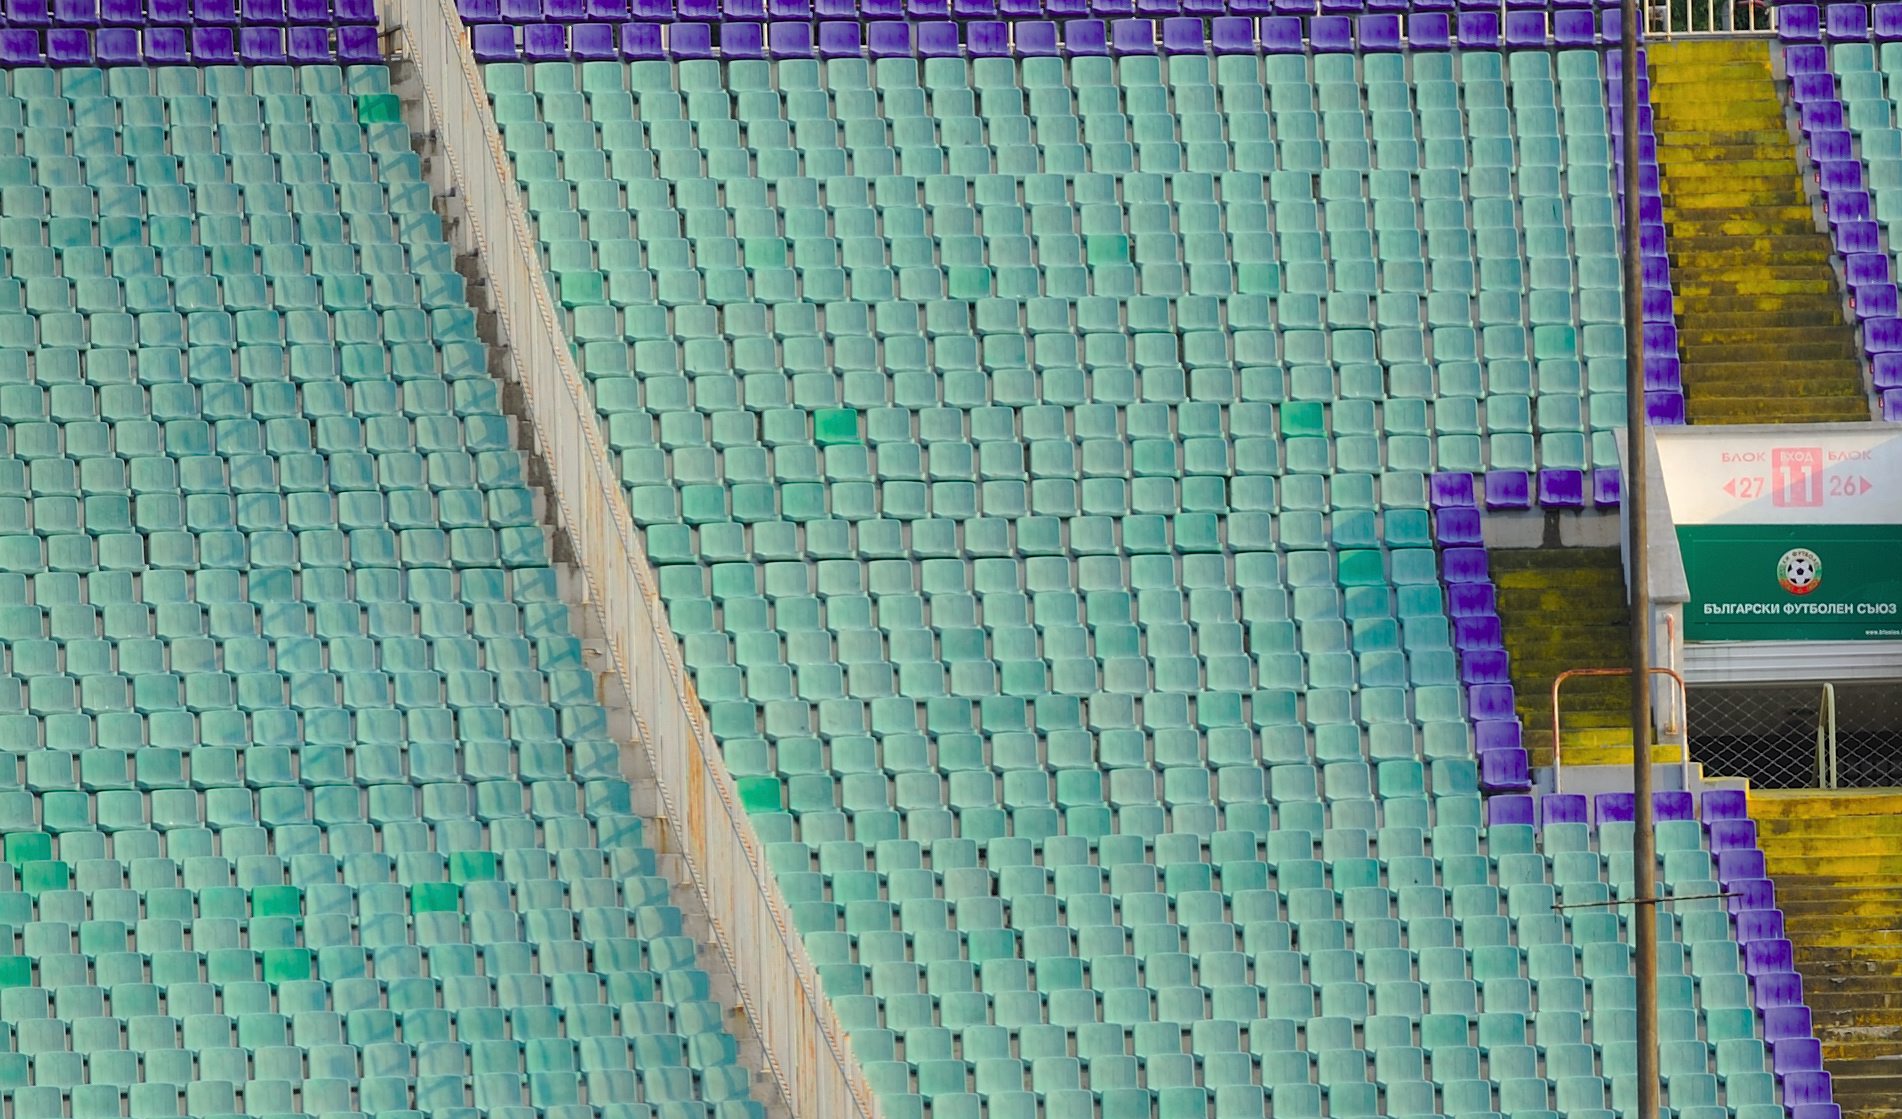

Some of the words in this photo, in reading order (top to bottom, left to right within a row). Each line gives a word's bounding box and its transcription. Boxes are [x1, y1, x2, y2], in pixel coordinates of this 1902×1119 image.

[1721, 452, 1766, 463] БЛОК
[1780, 451, 1815, 463] ВХОД
[1828, 450, 1873, 461] БЛОК
[1740, 477, 1765, 498] 27
[1780, 466, 1813, 503] 11
[1830, 475, 1856, 497] 26
[1703, 603, 1780, 615] БЪЛГАРСКИ
[1783, 603, 1854, 615] ФУТБОЛЕН
[1856, 603, 1897, 615] СЪЮЗ
